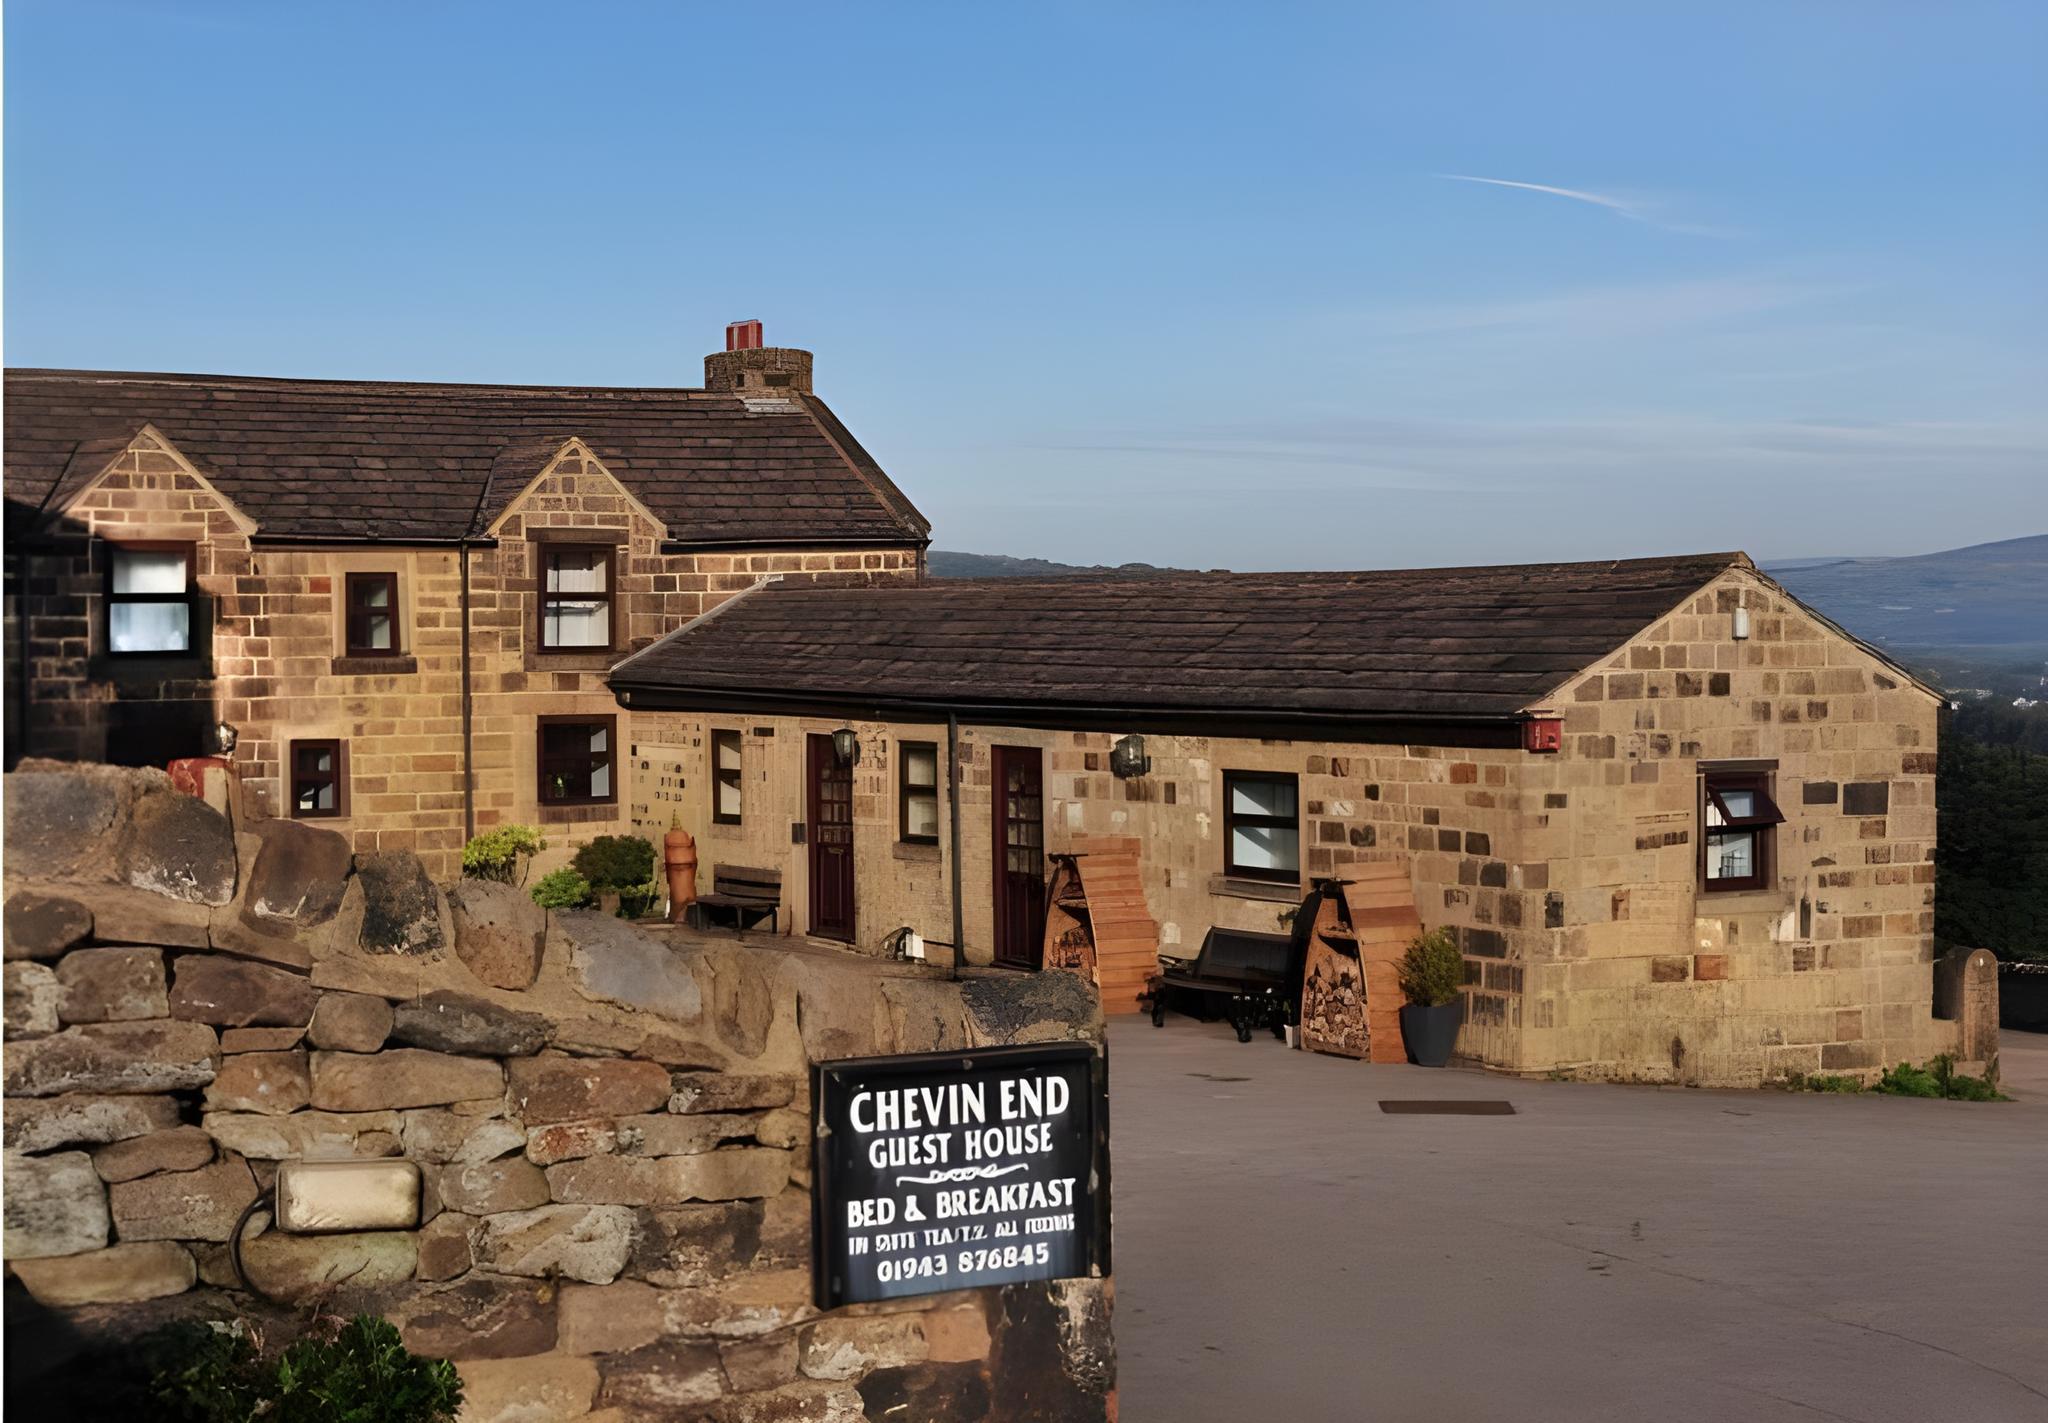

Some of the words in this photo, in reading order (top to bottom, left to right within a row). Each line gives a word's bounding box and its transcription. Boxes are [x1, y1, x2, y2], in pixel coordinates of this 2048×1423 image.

[850, 1082, 985, 1133] CHEVIN
[1000, 1075, 1070, 1120] END
[868, 1132, 951, 1169] GUEST
[965, 1123, 1053, 1160] HOUSE
[848, 1198, 896, 1228] BED
[904, 1195, 926, 1222] &
[936, 1178, 1076, 1219] BREAKFAST
[877, 1257, 947, 1283] 01943
